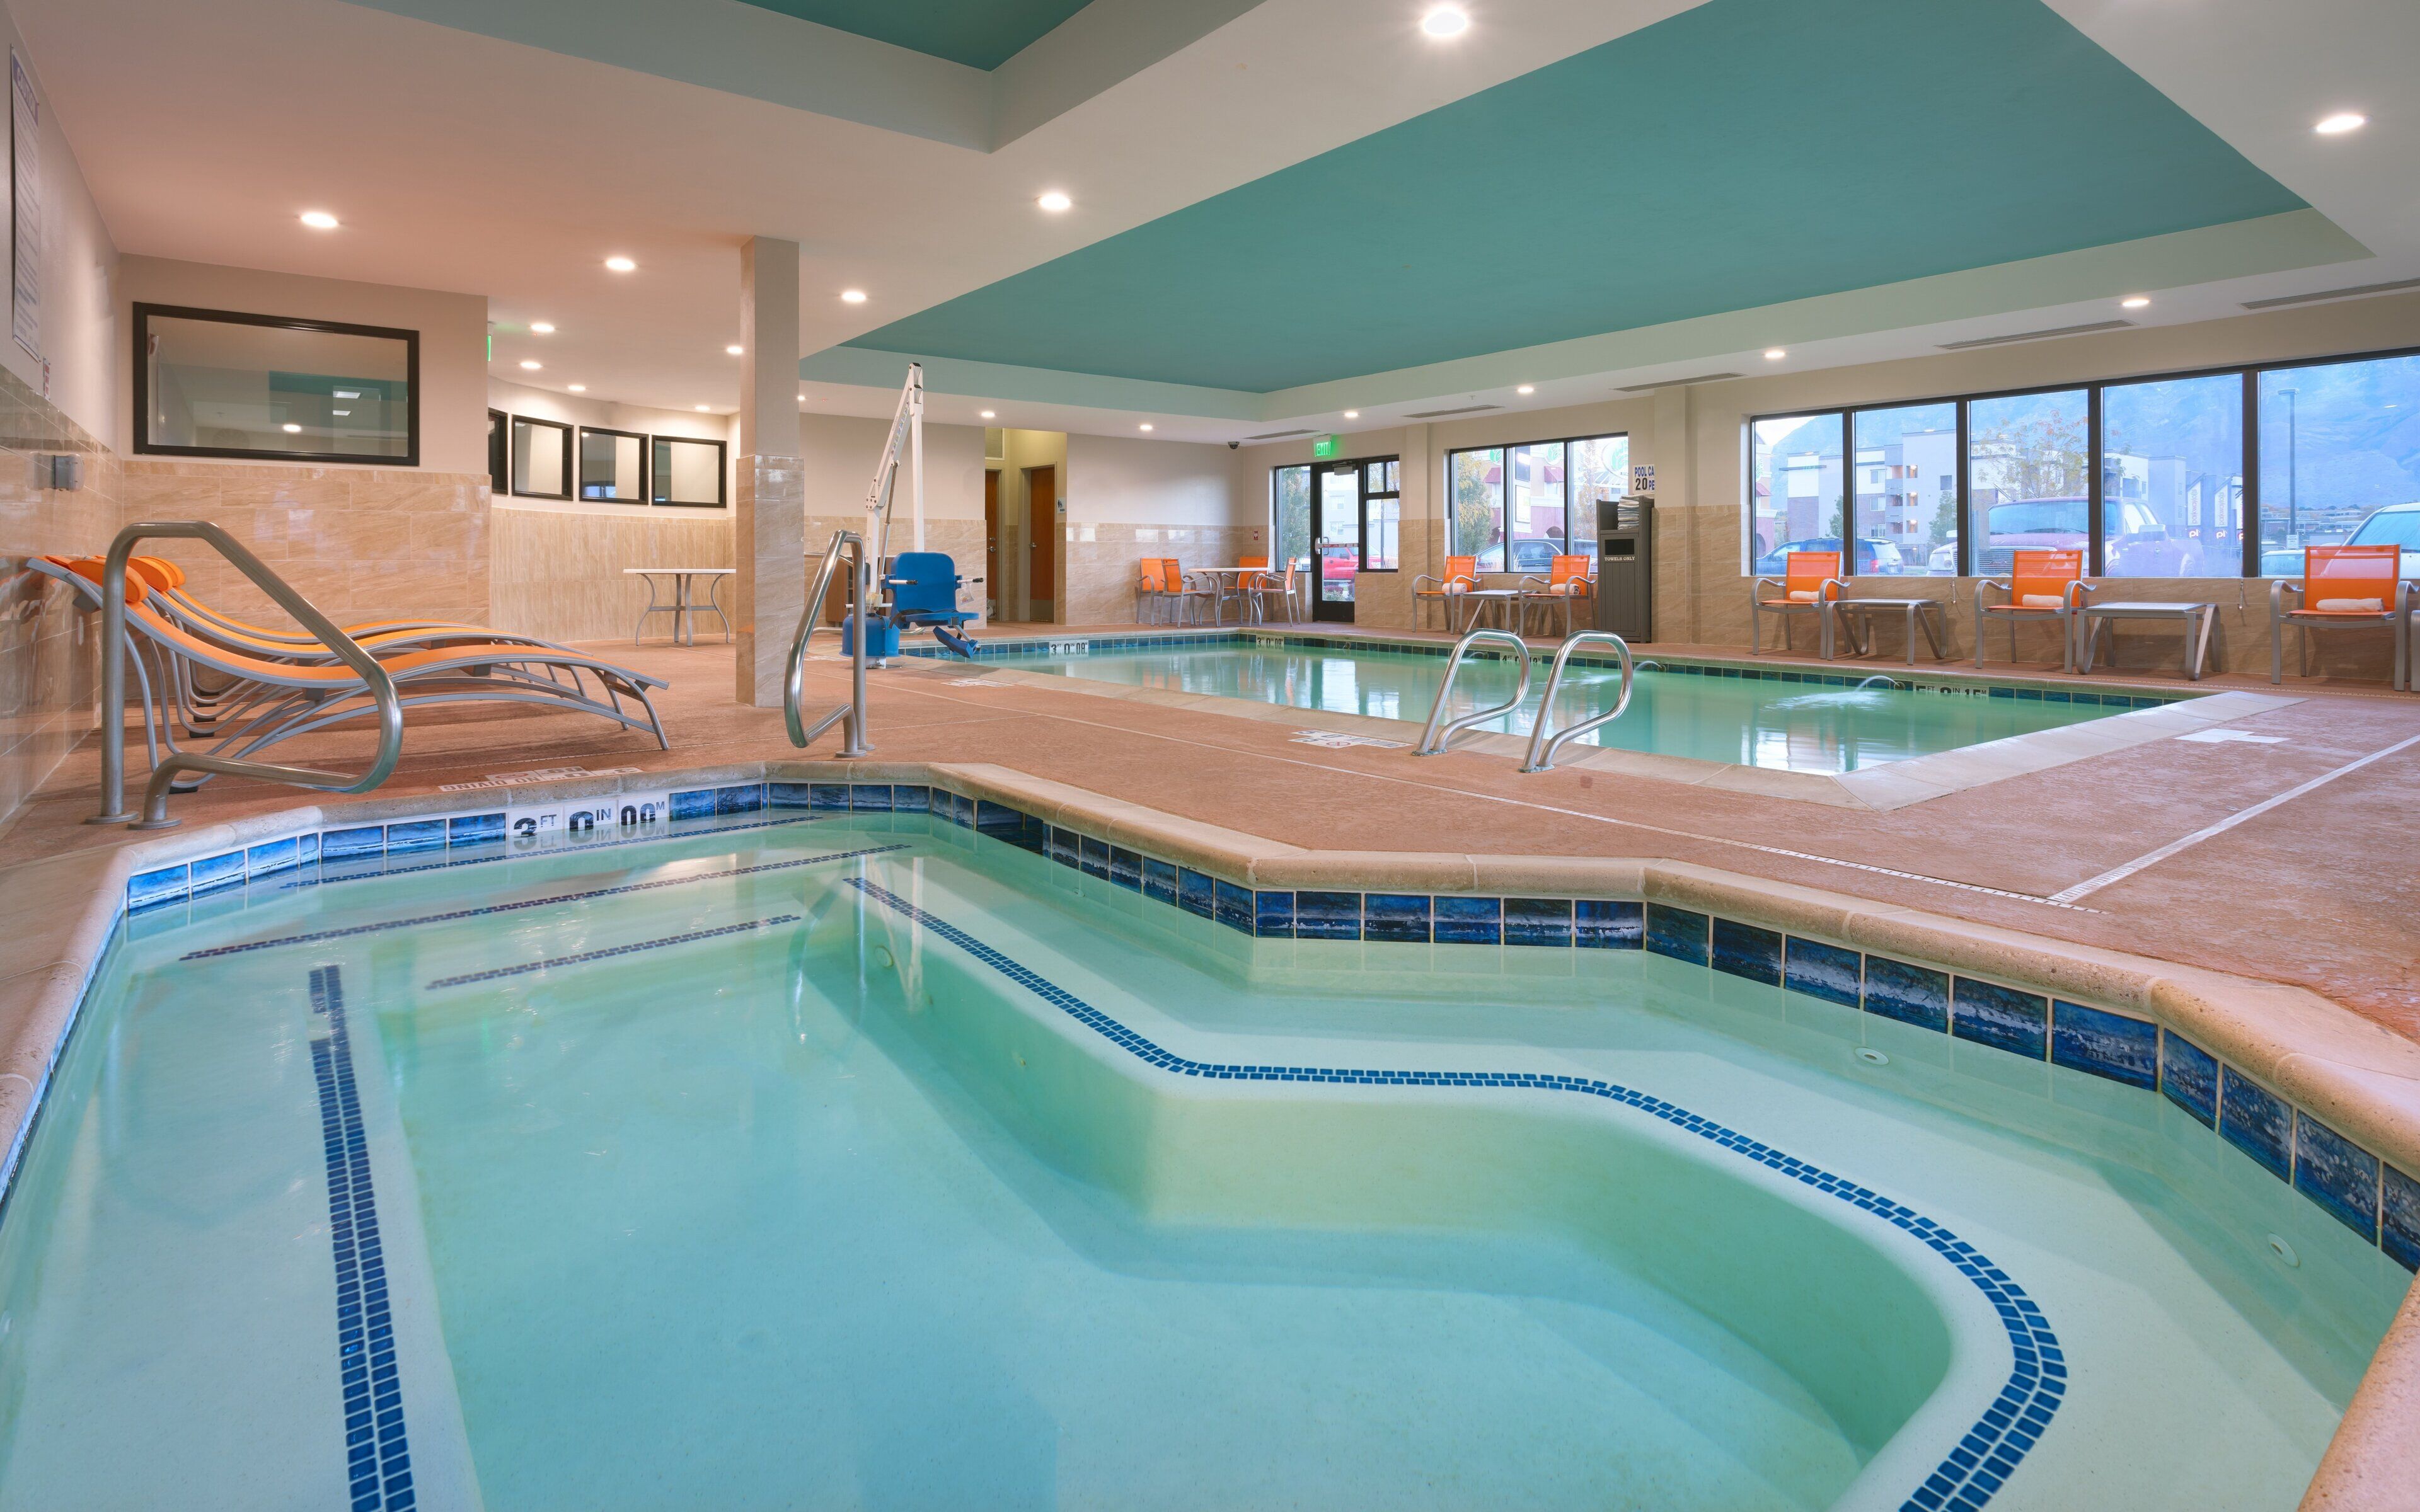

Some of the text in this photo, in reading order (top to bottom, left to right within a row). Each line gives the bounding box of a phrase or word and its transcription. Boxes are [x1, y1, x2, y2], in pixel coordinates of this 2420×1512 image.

[1317, 442, 1328, 455] EXIT
[1634, 467, 1647, 477] POOL
[1648, 466, 1654, 476] CA
[1635, 478, 1654, 490] 20 PE
[444, 780, 507, 791] DIVING
[514, 817, 537, 837] 3
[541, 814, 557, 828] FT
[596, 808, 611, 821] IN
[656, 801, 665, 810] M
